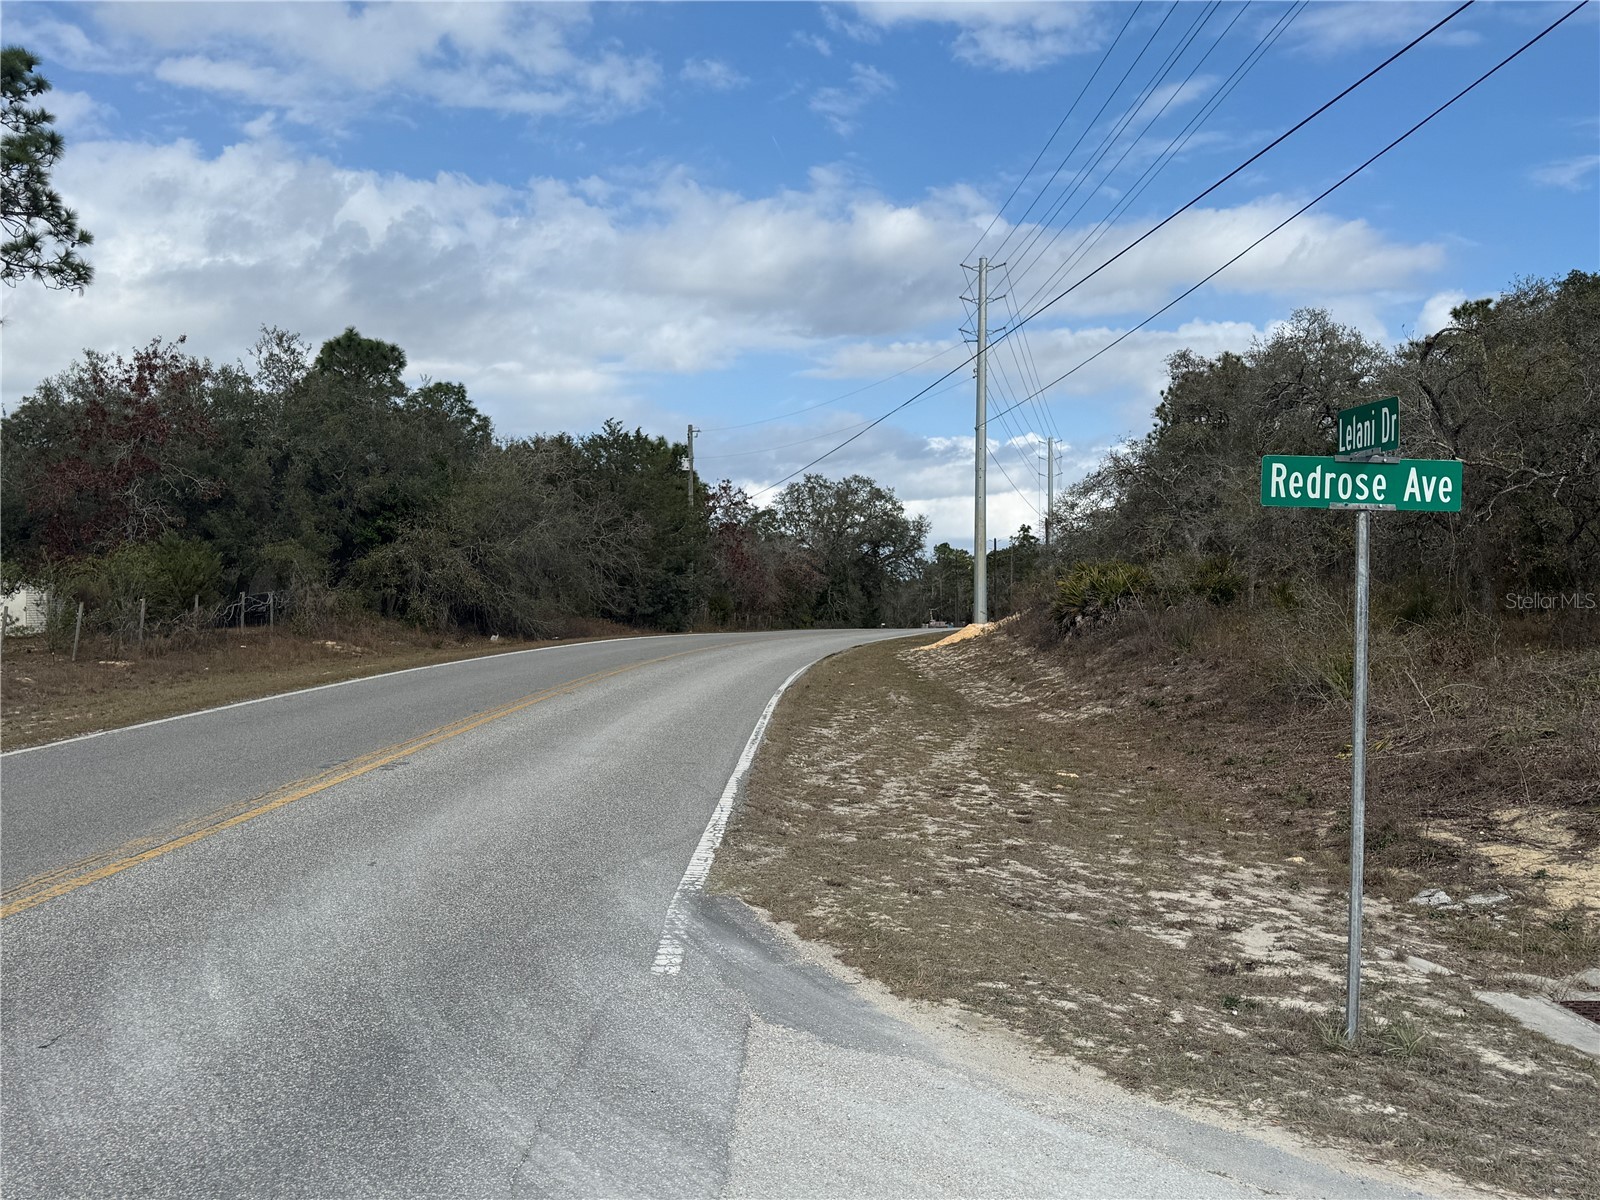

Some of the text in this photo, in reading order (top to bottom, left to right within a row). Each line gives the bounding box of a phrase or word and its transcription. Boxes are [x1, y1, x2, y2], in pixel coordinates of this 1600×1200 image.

[1338, 406, 1397, 452] Lelani Dr
[1270, 462, 1453, 503] Redrose Ave
